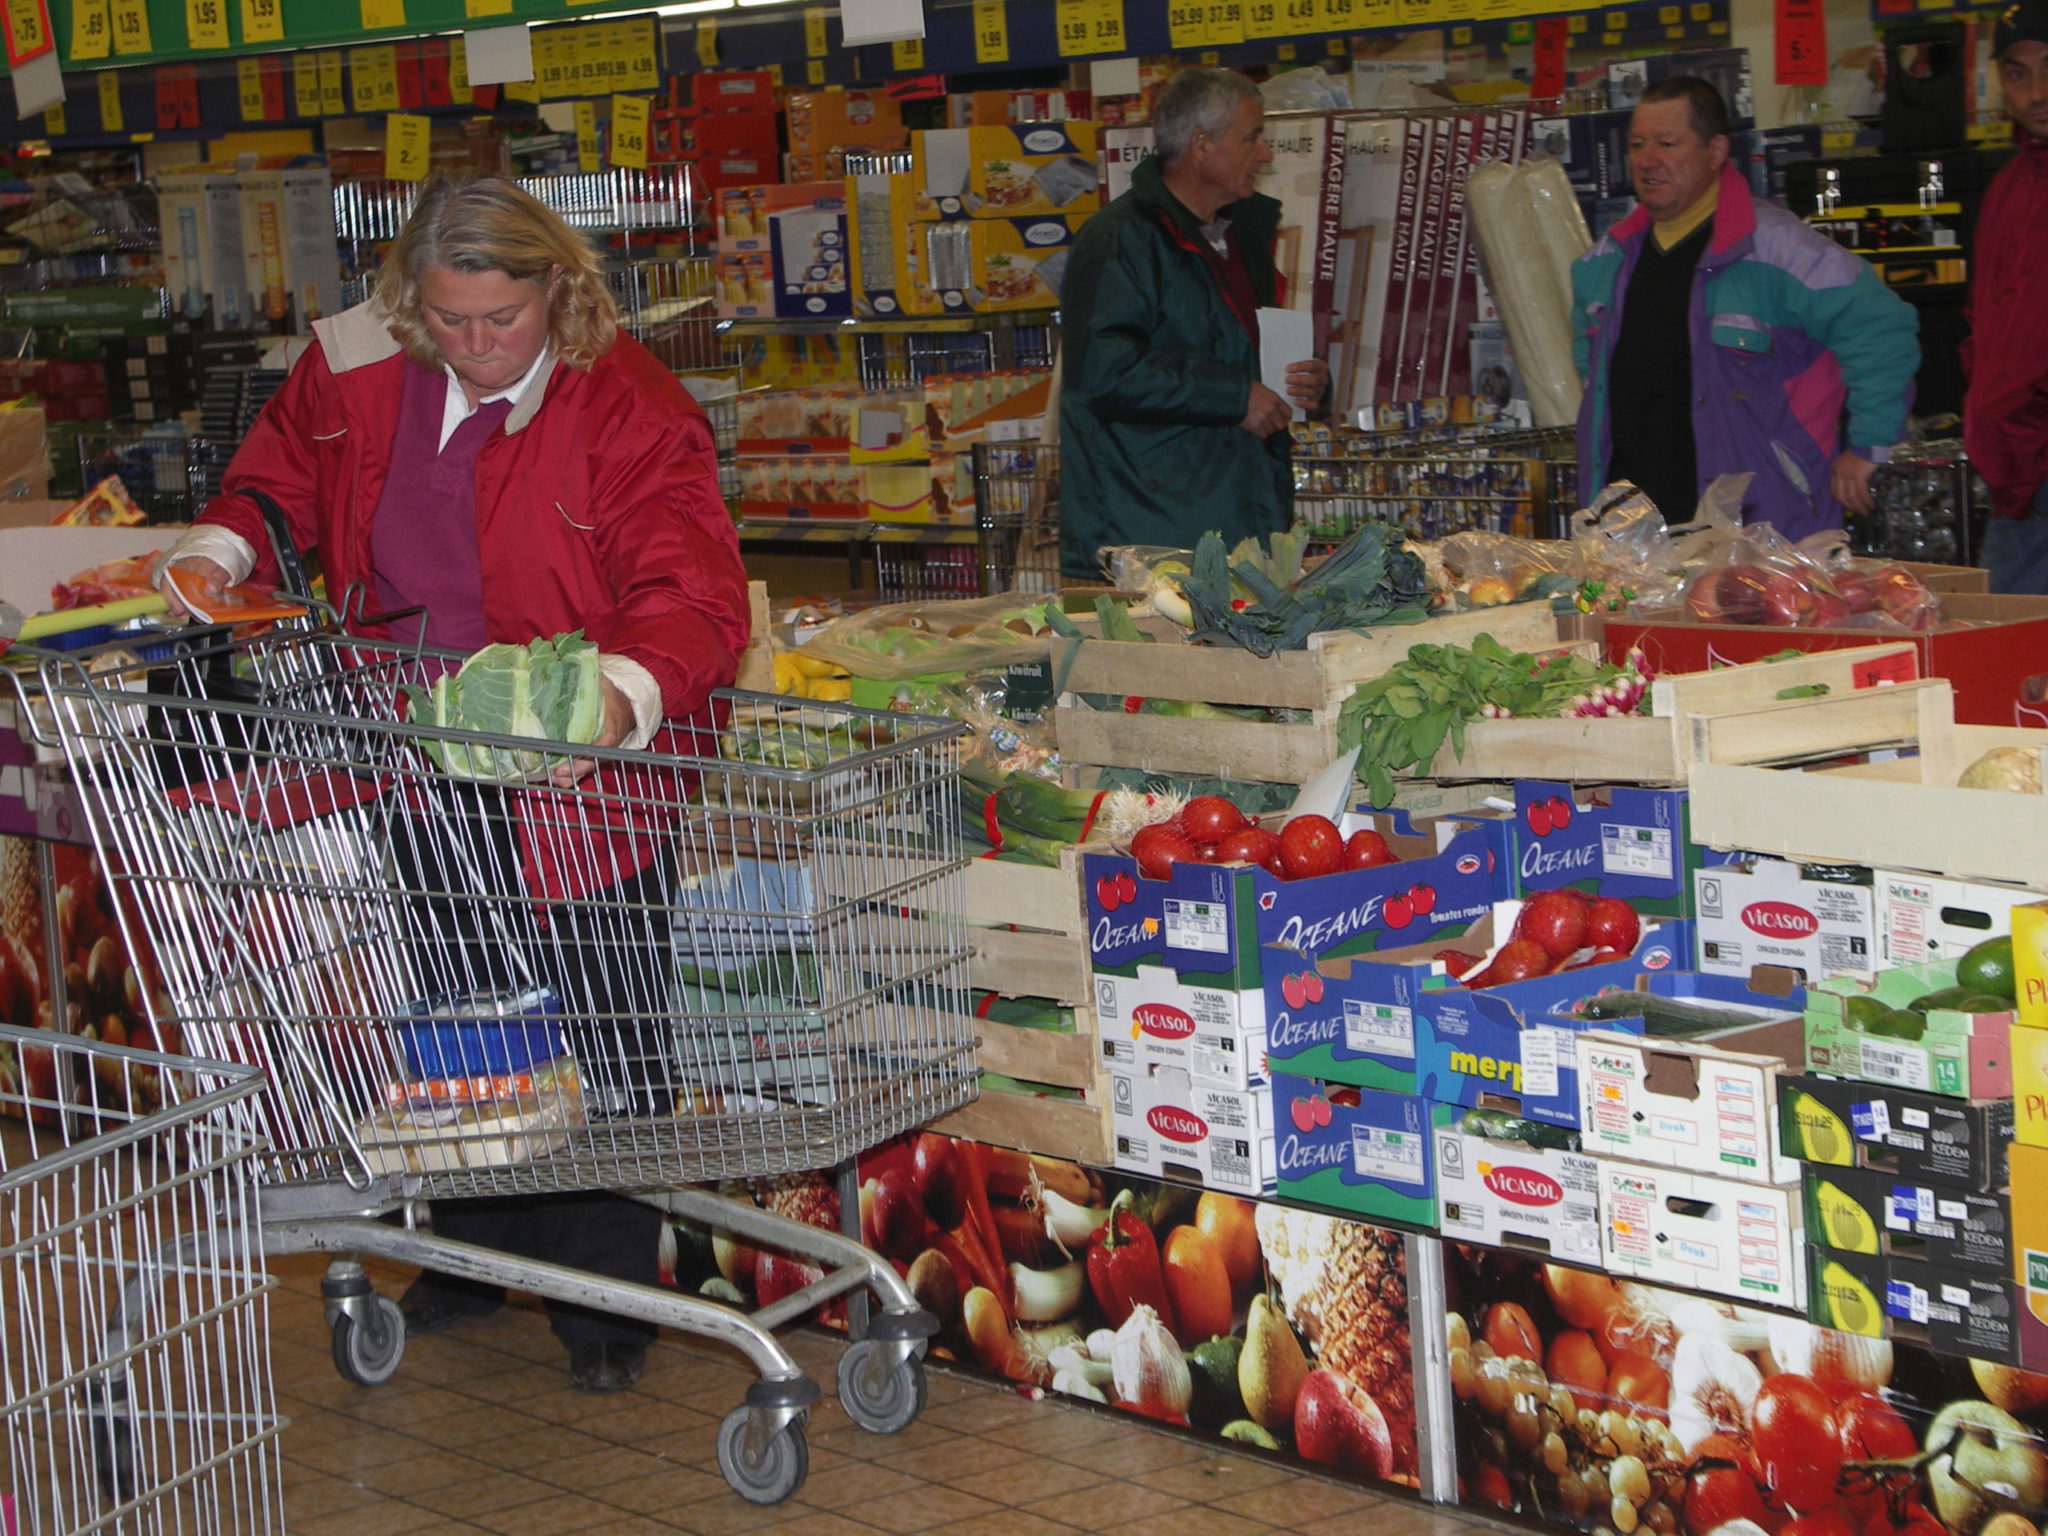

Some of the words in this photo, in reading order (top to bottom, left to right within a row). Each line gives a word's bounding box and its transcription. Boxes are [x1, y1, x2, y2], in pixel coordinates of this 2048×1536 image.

[617, 132, 643, 151] 5.49
[1319, 220, 1339, 282] HAUTE
[1392, 221, 1418, 282] HAUTE
[1417, 219, 1440, 281] HAUTE
[1440, 216, 1462, 280] HAUTE
[1520, 842, 1600, 879] OCEANE
[1277, 894, 1384, 951] OCEANE
[1429, 910, 1462, 925] Tomates
[1462, 903, 1490, 918] rondes
[1270, 1011, 1344, 1049] OCEANE
[1936, 1061, 1957, 1081] 14
[1279, 1133, 1352, 1170] OCEANE
[1931, 1142, 1971, 1161] KEDEM
[1963, 1230, 2006, 1249] KEDEM
[1968, 1314, 2010, 1335] KEDEM
